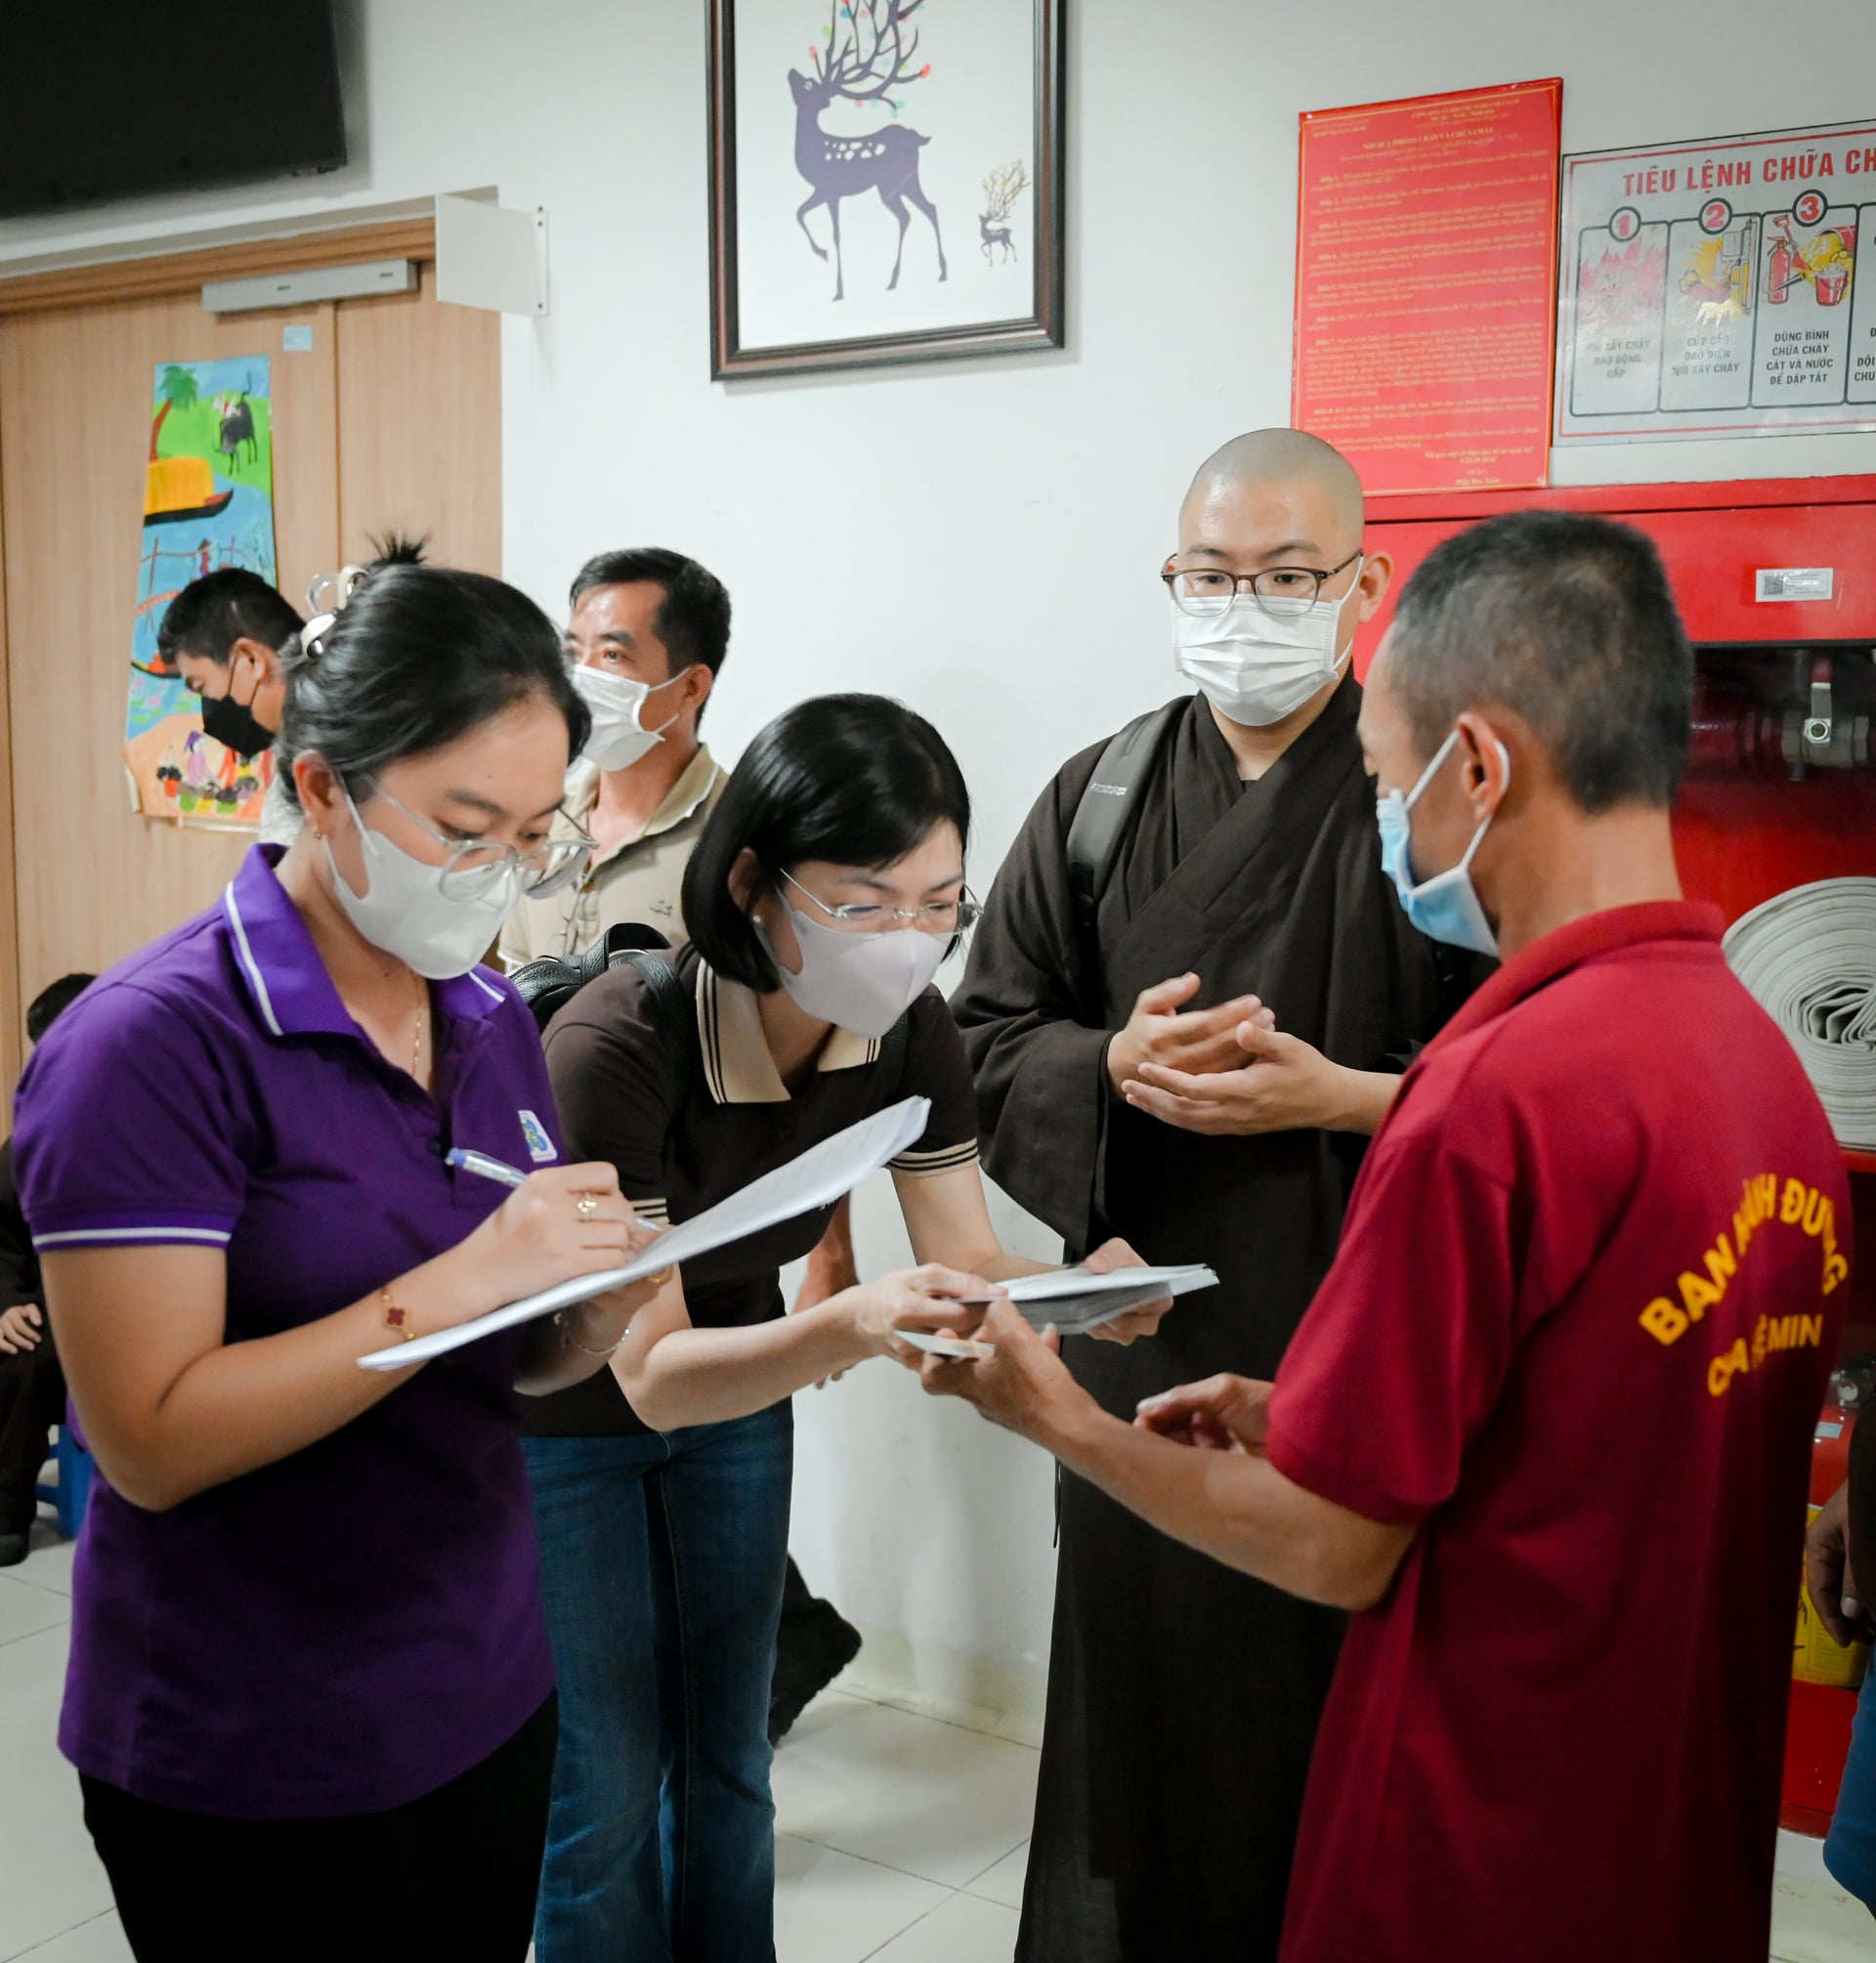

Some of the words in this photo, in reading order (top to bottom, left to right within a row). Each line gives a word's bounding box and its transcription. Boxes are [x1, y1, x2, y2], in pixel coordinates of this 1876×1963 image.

[1623, 165, 1676, 196] TIÊU
[1686, 159, 1752, 193] LỆNH
[1763, 149, 1834, 183] CHỮA
[1706, 204, 1726, 229] 2
[1800, 195, 1819, 221] 3
[1615, 214, 1630, 237] 1
[1771, 344, 1799, 356] CHỮA
[1639, 1232, 1737, 1346] BAN
